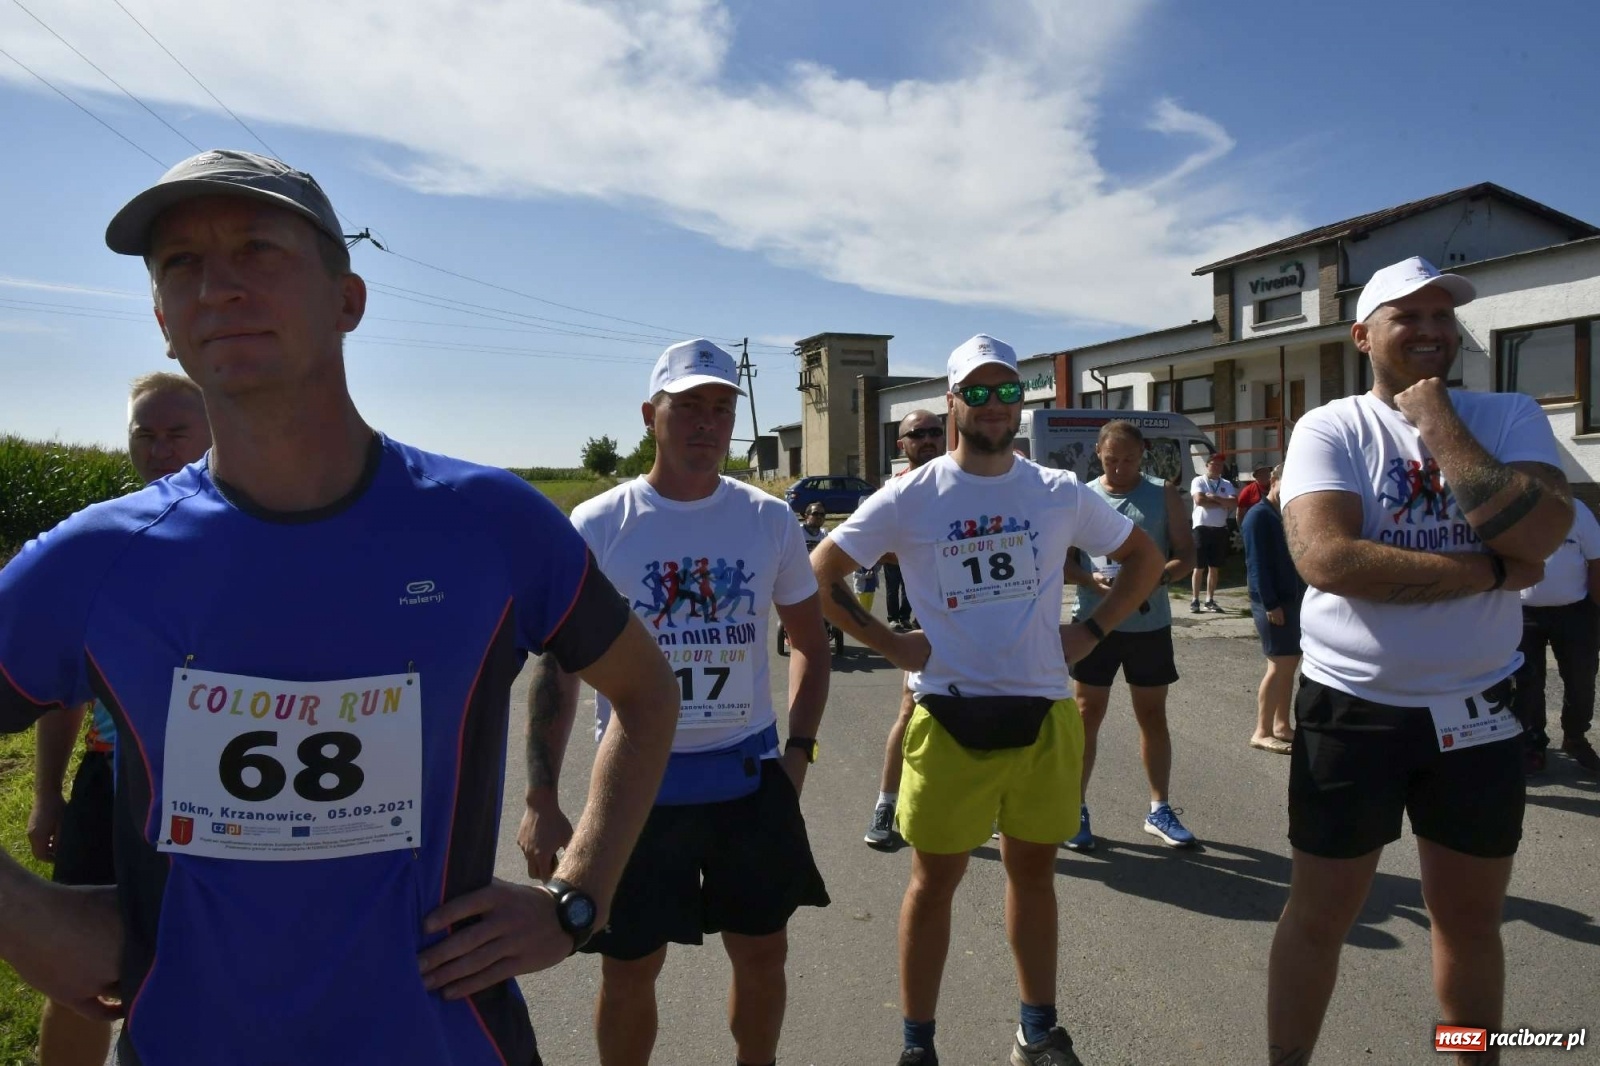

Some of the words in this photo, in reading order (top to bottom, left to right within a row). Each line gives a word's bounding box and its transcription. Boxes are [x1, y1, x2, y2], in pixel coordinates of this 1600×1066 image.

[1143, 418, 1169, 428] CZASU
[1453, 523, 1482, 545] RU
[942, 540, 994, 558] COLOUR
[1001, 535, 1024, 549] RUN
[962, 552, 1015, 585] 18
[399, 591, 445, 605] Kalenji
[655, 627, 722, 646] OLOUR
[726, 622, 756, 645] RUN
[663, 649, 713, 664] OLOUR
[720, 649, 746, 664] RUN
[674, 667, 731, 701] 17
[188, 683, 321, 726] COLOUR
[339, 686, 402, 723] RUN
[681, 703, 714, 711] zanowice,
[218, 730, 365, 802] 68
[172, 800, 214, 817] 10km,
[220, 806, 317, 822] Krzanowice,
[327, 799, 413, 820] 05.09.2021
